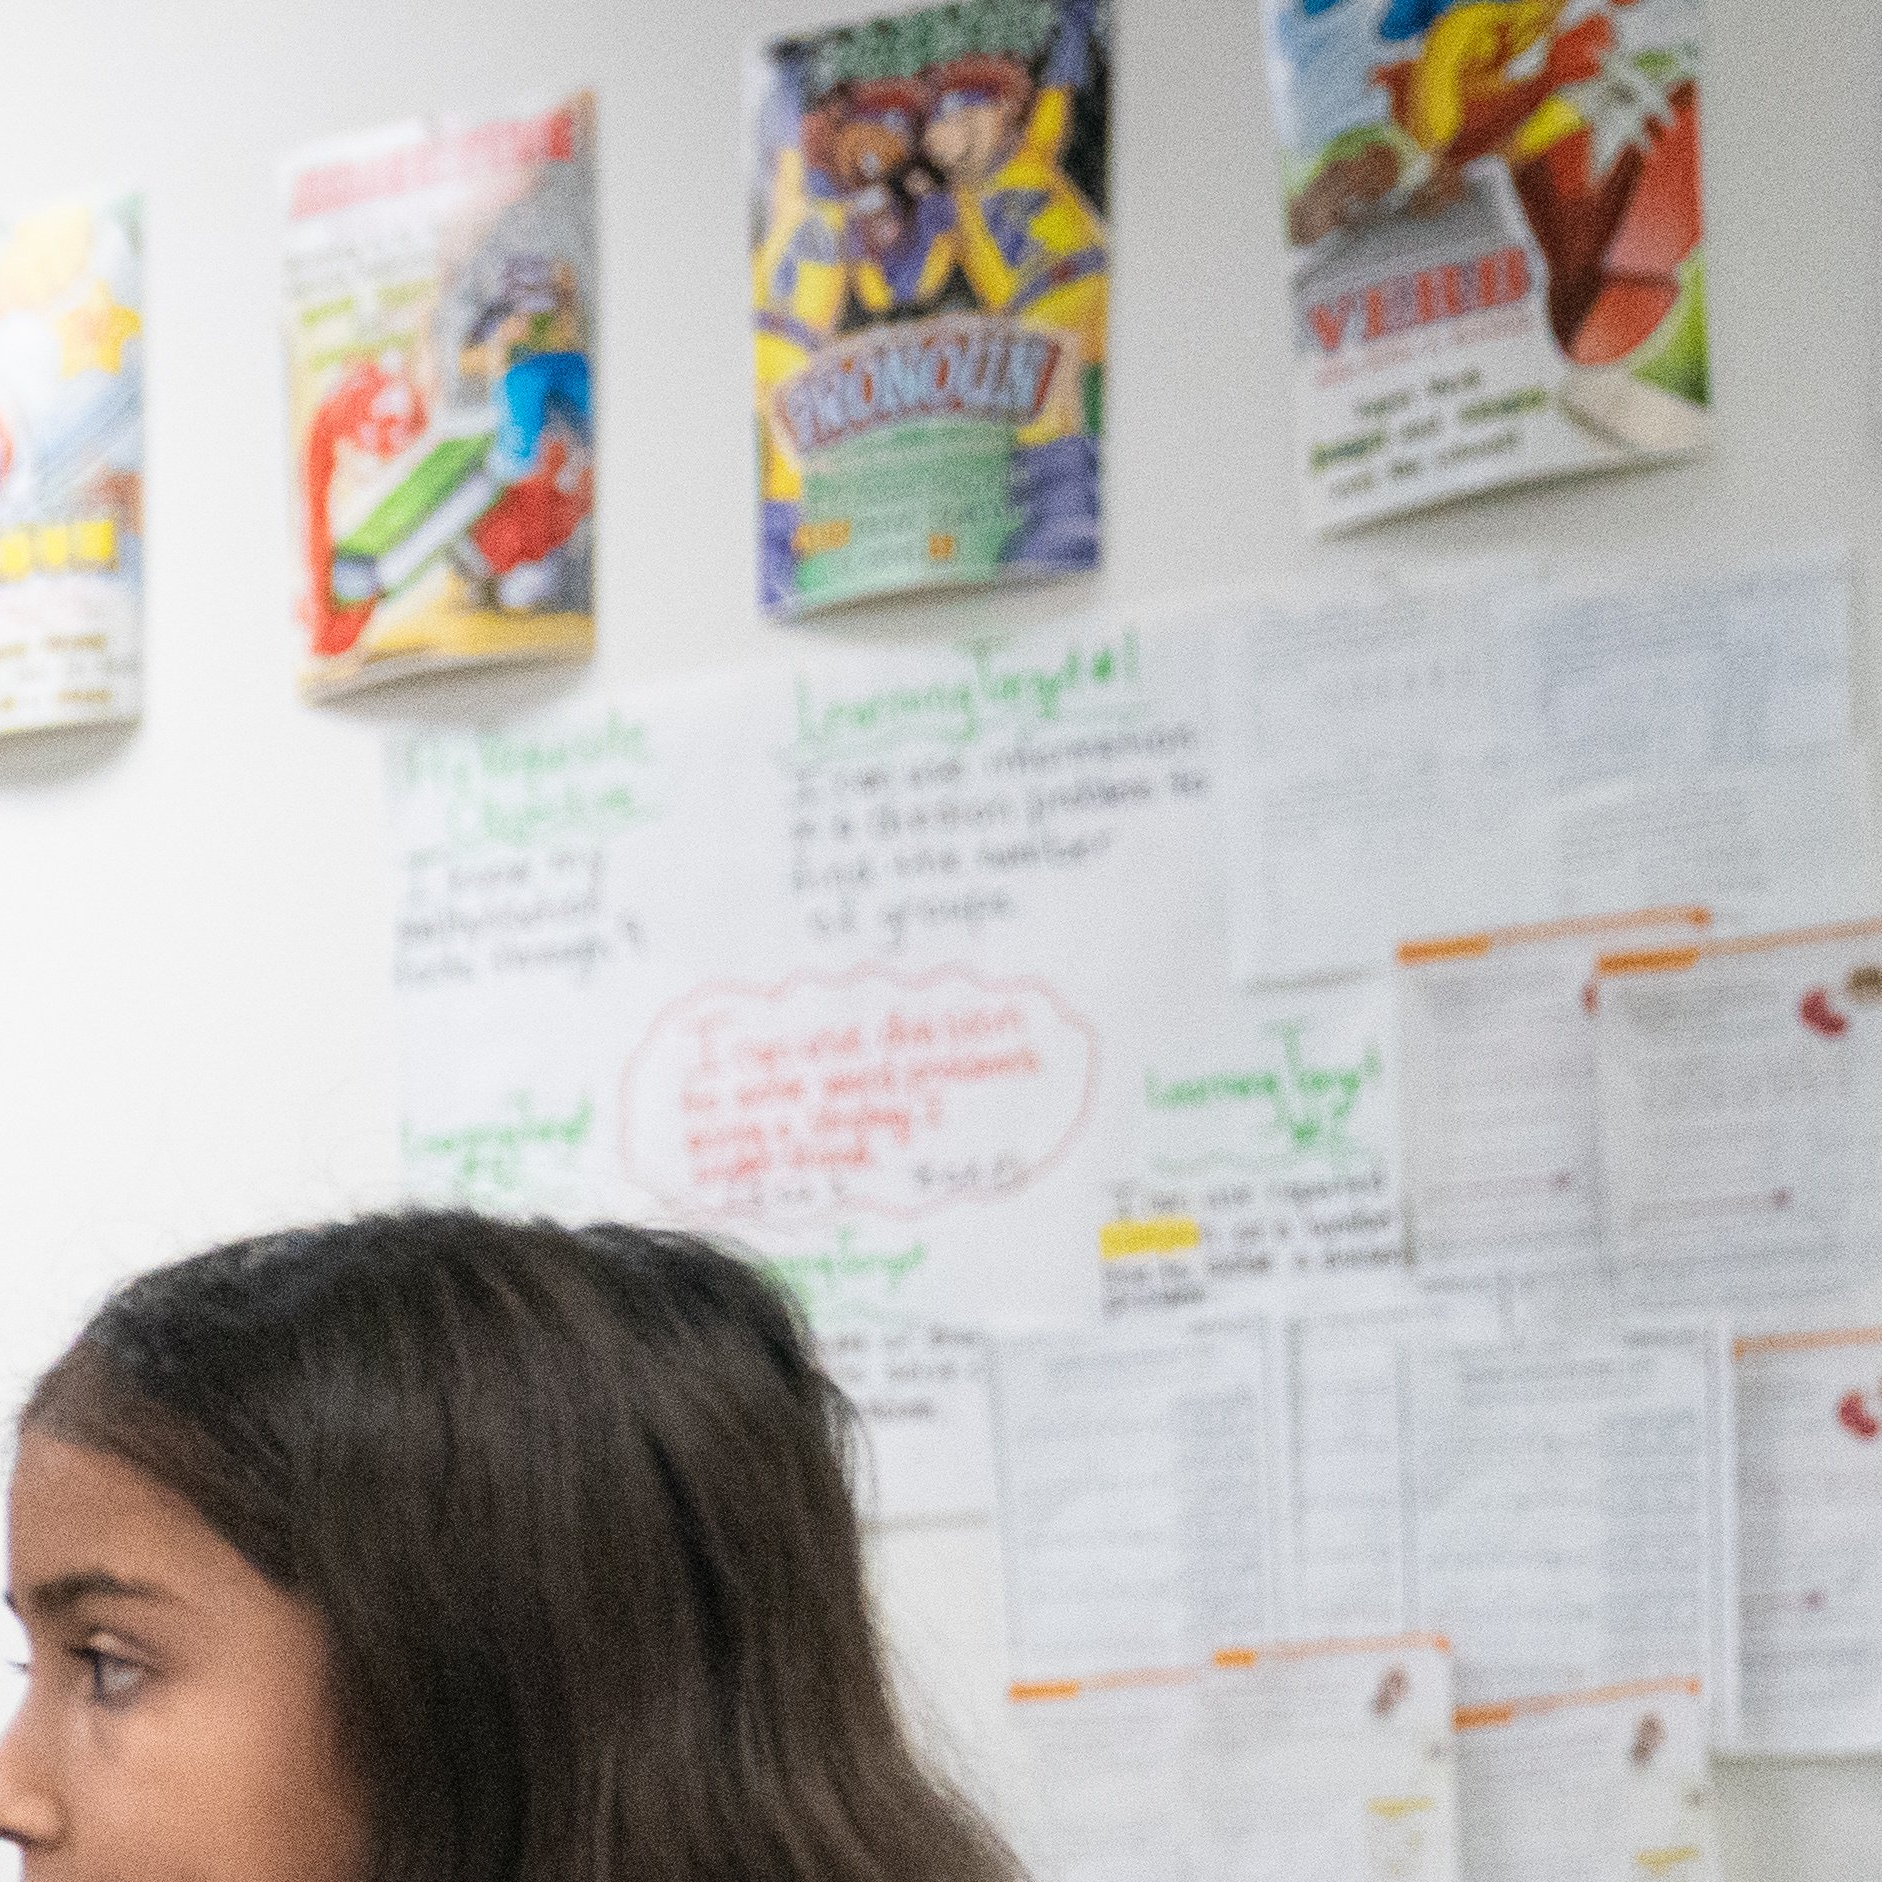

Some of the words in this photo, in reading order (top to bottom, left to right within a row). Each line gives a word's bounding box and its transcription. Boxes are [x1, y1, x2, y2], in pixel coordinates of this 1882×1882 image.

[1304, 245, 1531, 355] VERB
[781, 328, 1062, 452] PRONOUN
[796, 670, 980, 755] Learning
[952, 632, 1082, 722] Target
[908, 756, 963, 788] use
[988, 722, 1196, 772] information
[1168, 770, 1208, 796] to
[979, 828, 1113, 870] number
[1144, 1062, 1290, 1140] Learning
[1258, 1016, 1382, 1122] Target
